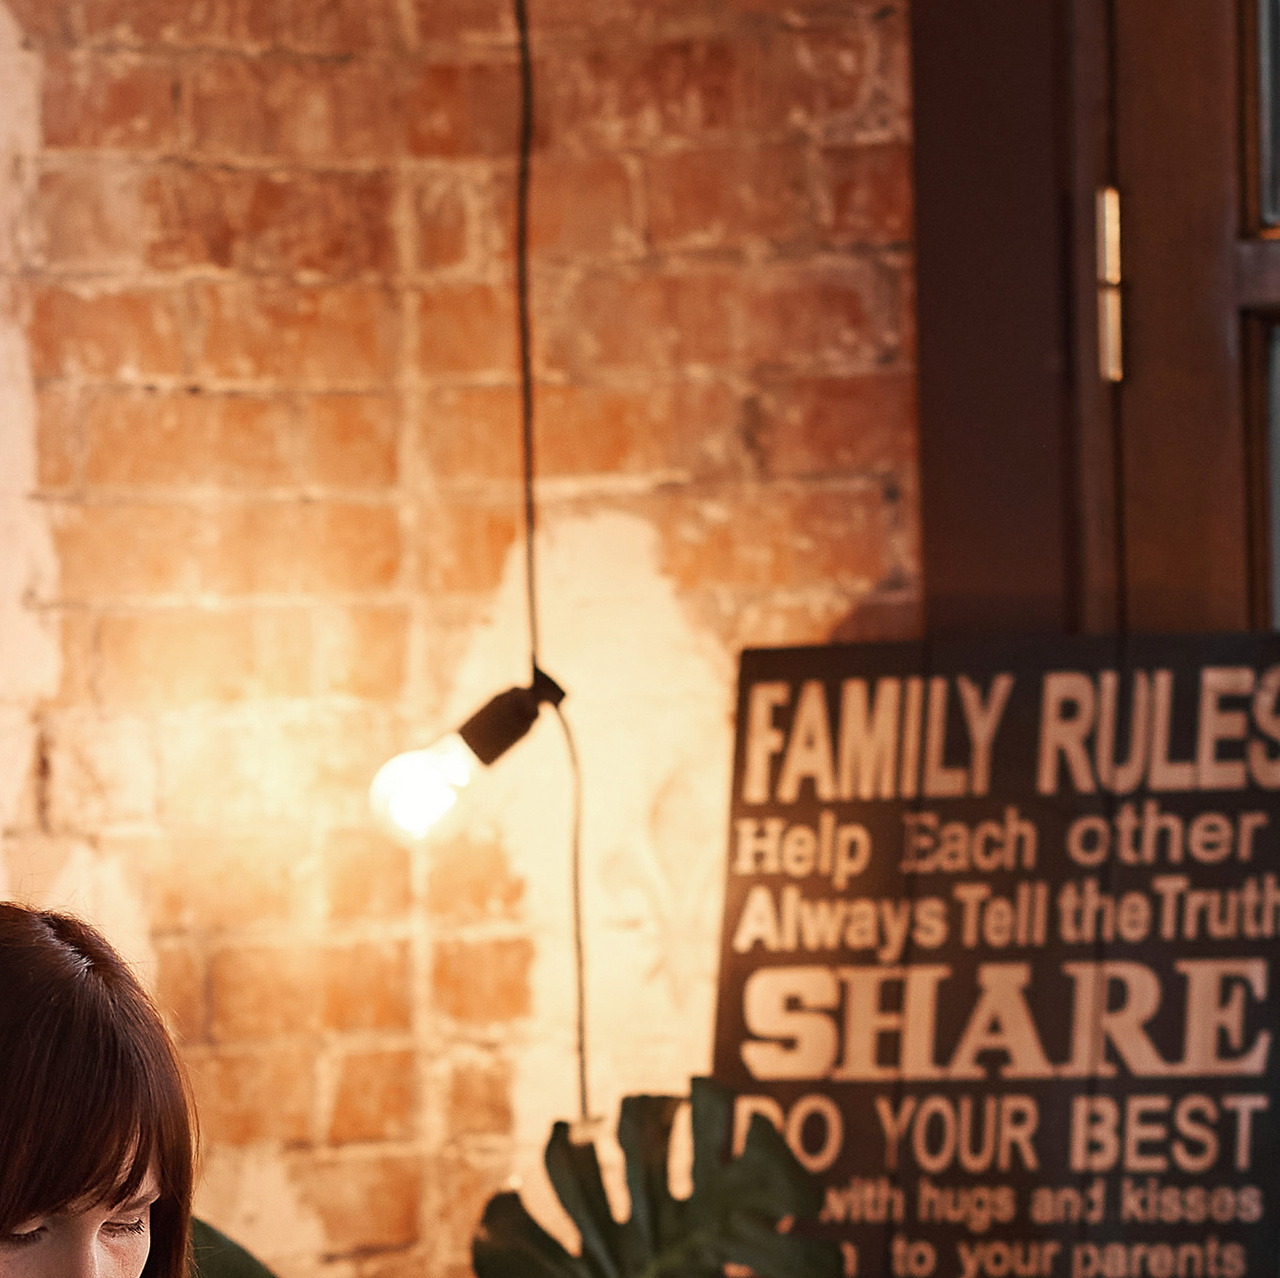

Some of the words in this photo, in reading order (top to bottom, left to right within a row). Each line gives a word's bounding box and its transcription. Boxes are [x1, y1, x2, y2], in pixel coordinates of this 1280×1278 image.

[742, 672, 1014, 802] FAMILY
[734, 809, 872, 891] Help
[900, 806, 1037, 873] Each
[1067, 800, 1267, 866] other
[732, 885, 948, 965] Always
[953, 880, 1048, 948] Tell
[1059, 876, 1151, 943] the
[740, 957, 1271, 1083] SHARE
[874, 1094, 1040, 1174] YOUR
[1069, 1093, 1269, 1174] BEST
[918, 1176, 1017, 1232] hugs
[1030, 1177, 1106, 1224] and
[1121, 1177, 1264, 1224] kisses
[891, 1233, 937, 1278] to
